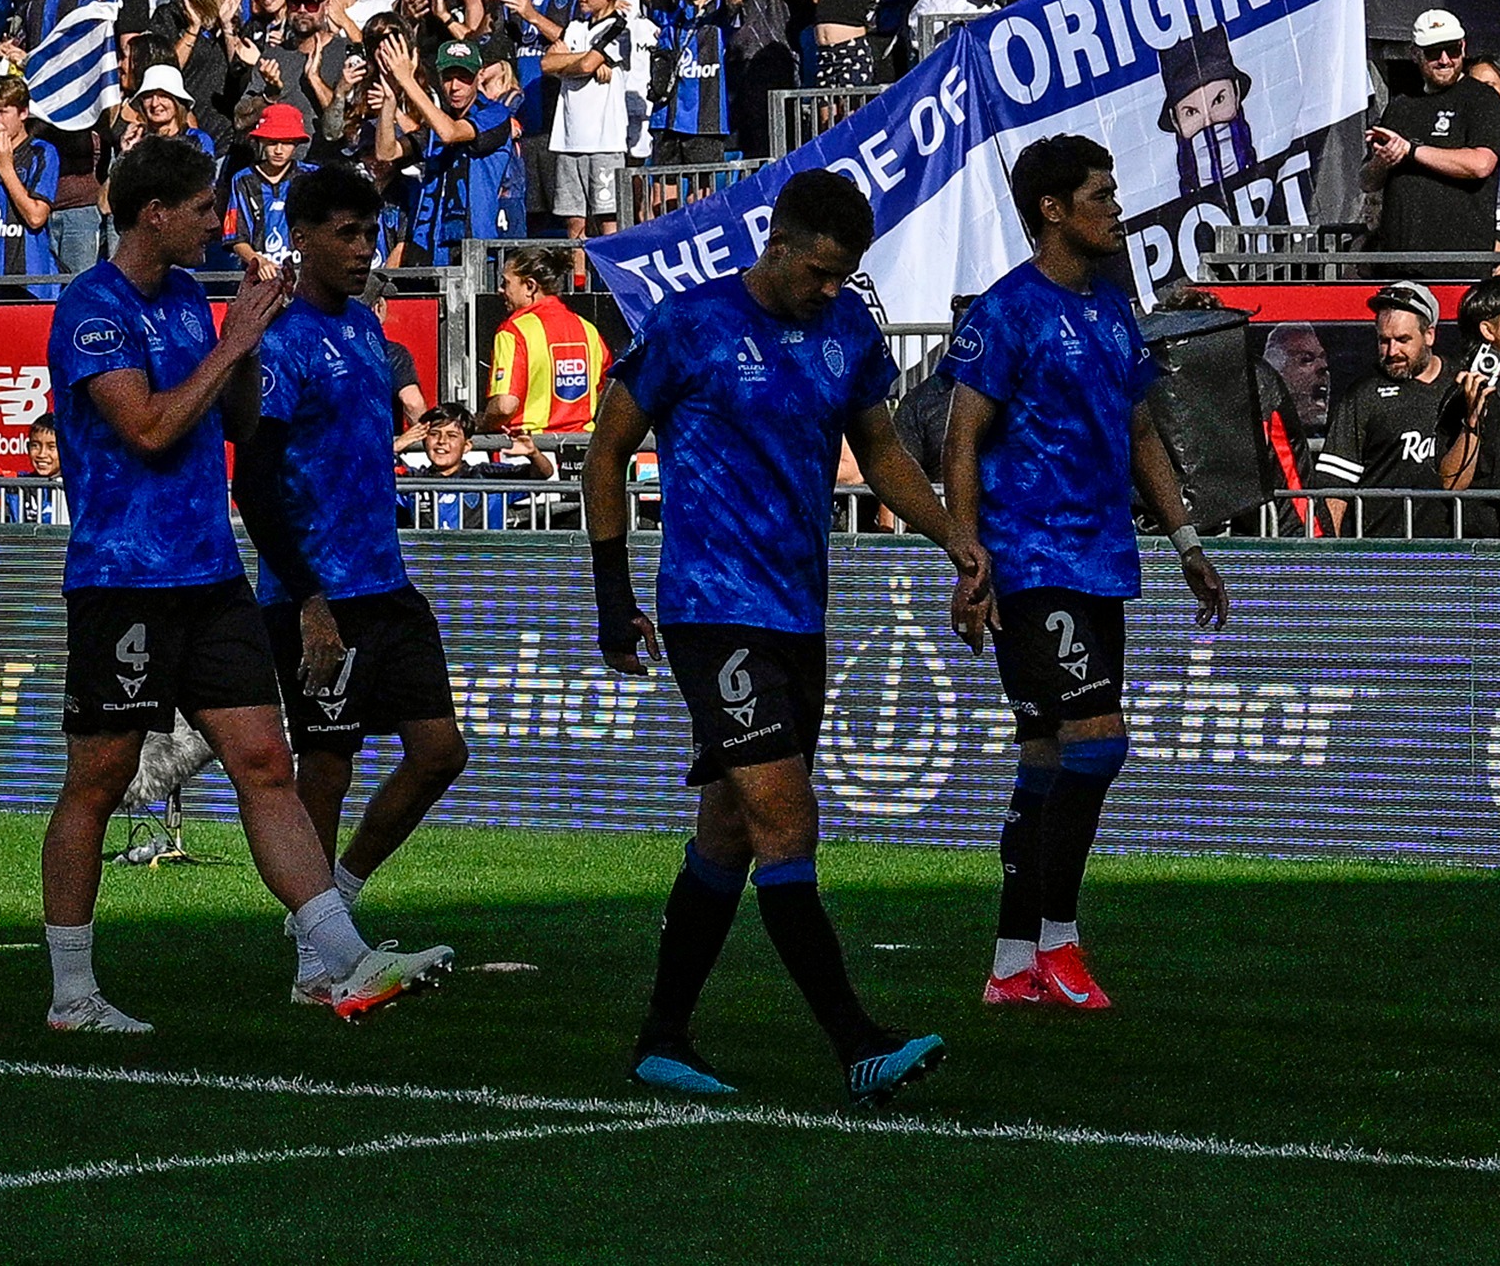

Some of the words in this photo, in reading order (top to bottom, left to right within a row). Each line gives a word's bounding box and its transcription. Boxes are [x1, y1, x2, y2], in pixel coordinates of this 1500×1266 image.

[616, 224, 740, 305] THE
[743, 131, 906, 260] PDE
[909, 65, 969, 156] OF
[555, 357, 586, 378] RED
[556, 375, 587, 389] BADGE
[115, 622, 150, 672] 4
[1044, 610, 1086, 658] 2
[717, 647, 753, 703] 6
[722, 722, 783, 749] CUPRA
